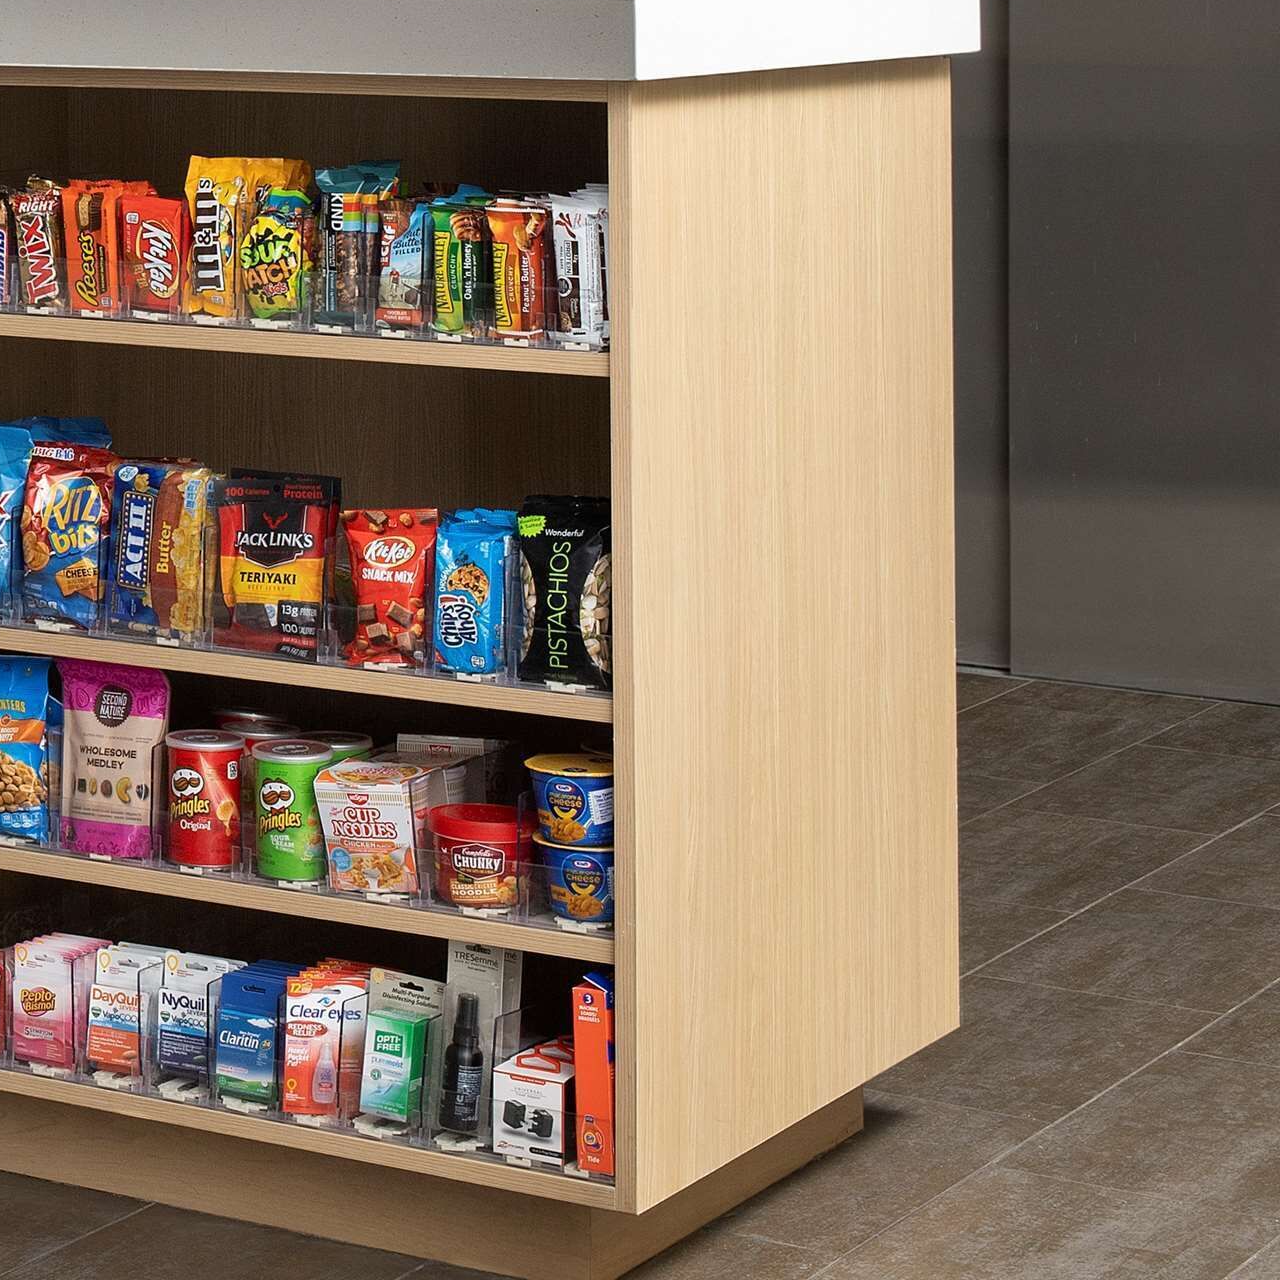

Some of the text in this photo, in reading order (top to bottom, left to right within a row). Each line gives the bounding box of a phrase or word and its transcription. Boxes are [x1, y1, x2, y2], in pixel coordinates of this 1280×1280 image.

[18, 200, 54, 213] RIGHT
[331, 192, 344, 231] KIND
[395, 247, 421, 256] FILLED
[464, 243, 473, 269] Honey
[434, 233, 451, 309] NATURE VALLEY
[464, 280, 472, 300] Oats
[521, 256, 530, 313] Peanut Butter
[283, 489, 323, 499] Protein
[42, 482, 101, 530] RITZ
[50, 523, 99, 554] bits
[235, 531, 313, 548] JACK LINK'S
[545, 528, 584, 537] Wonderful
[156, 521, 172, 573] Butter
[239, 571, 296, 585] TERIYAKI
[361, 567, 394, 582] SNACK
[281, 604, 298, 617] 13g
[547, 541, 571, 668] PISTACHIOS
[281, 623, 298, 633] 100
[101, 692, 128, 706] SECOND
[100, 705, 125, 718] NATURE
[80, 744, 137, 759] WHOLESOME
[86, 758, 125, 770] MEDLEY
[170, 796, 211, 818] Pringles
[344, 806, 380, 823] CUP
[179, 818, 211, 832] Original
[259, 810, 302, 836] Pringles
[332, 820, 397, 838] NOODLES
[344, 840, 376, 848] CHICKEN
[454, 853, 501, 872] CHUNKY
[382, 992, 415, 1005] Disinfecting
[392, 987, 431, 1001] Multi-Purpose
[585, 994, 592, 1004] 3
[24, 999, 56, 1013] Bismol
[161, 992, 205, 1012] NyQuil
[290, 1004, 361, 1023] Clear eyes
[288, 1023, 323, 1031] REDNESS
[219, 1030, 260, 1050] Claritin
[376, 1042, 401, 1052] FREE
[587, 1155, 600, 1164] Tide
